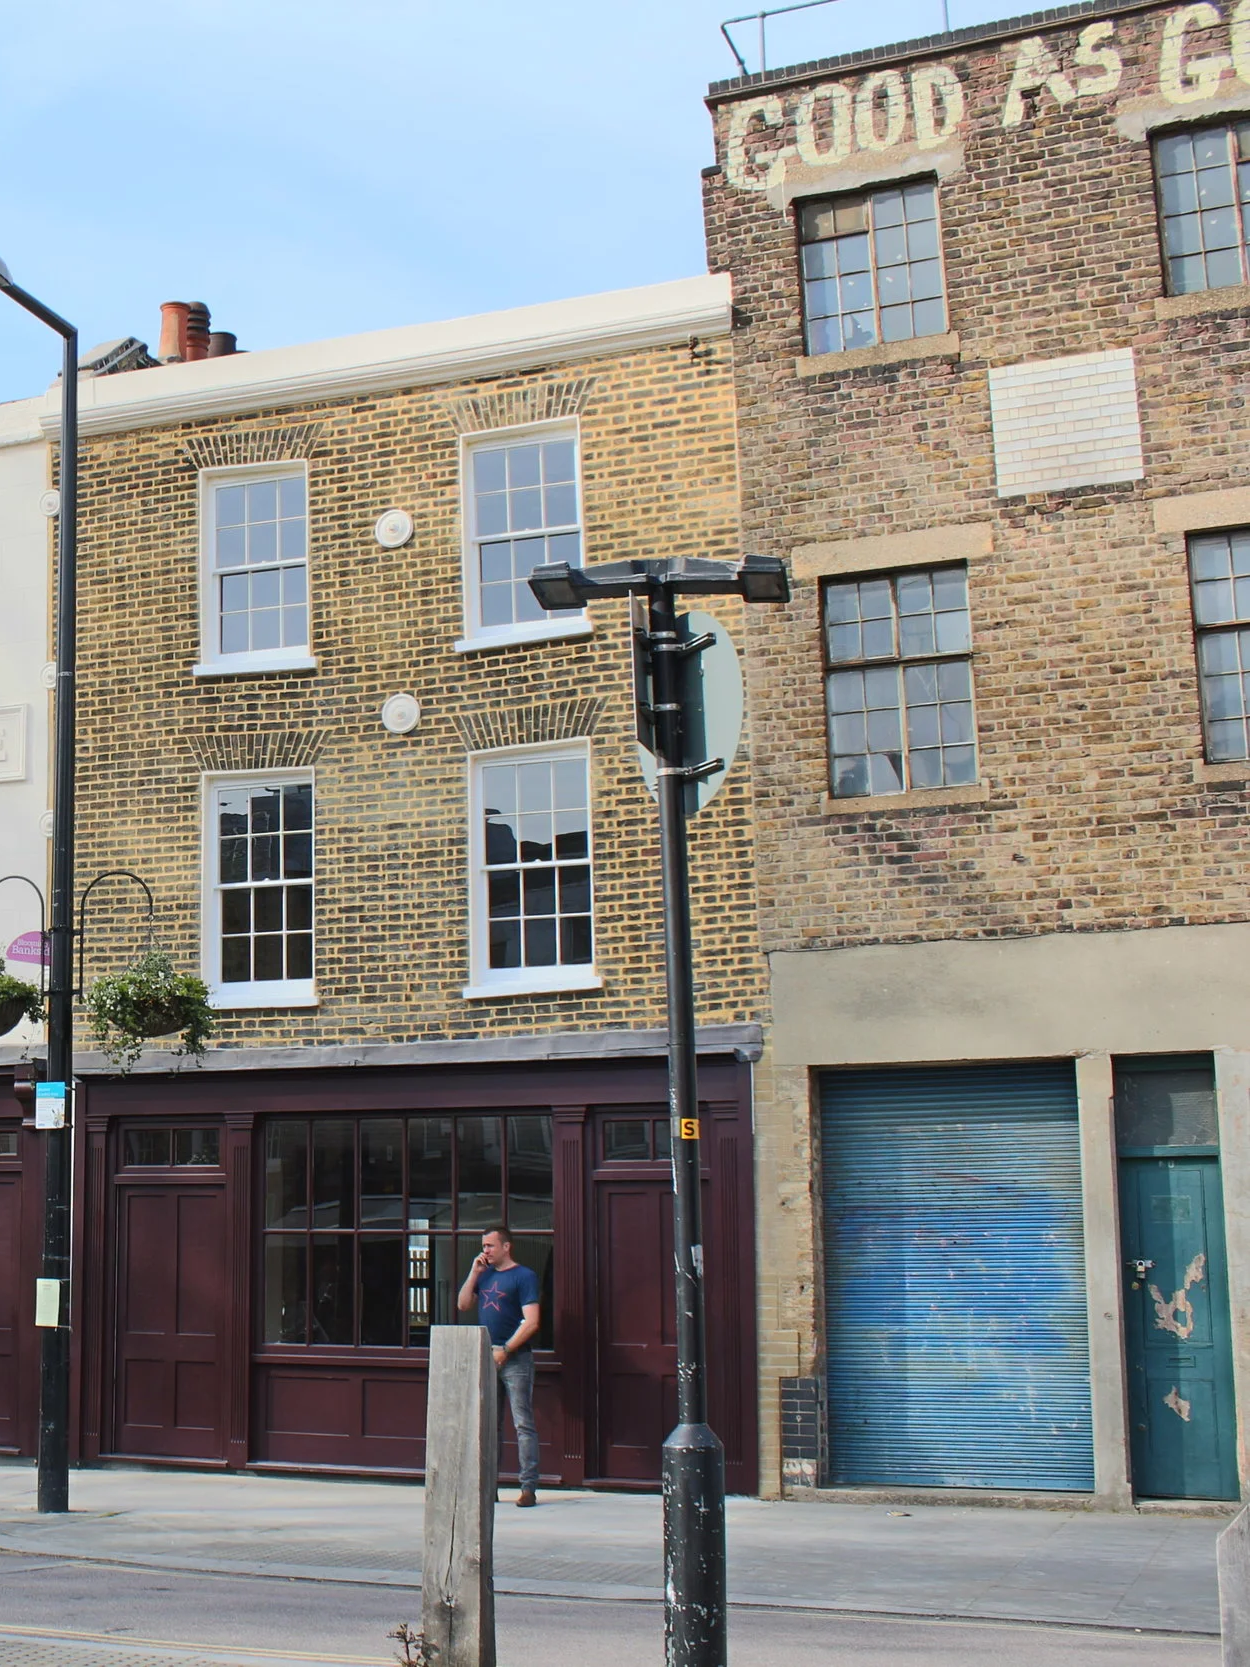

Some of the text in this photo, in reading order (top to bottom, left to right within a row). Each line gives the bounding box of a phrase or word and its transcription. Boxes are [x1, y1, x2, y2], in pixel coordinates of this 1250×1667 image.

[725, 2, 1250, 190] GOOD AS G
[683, 1120, 695, 1136] S
